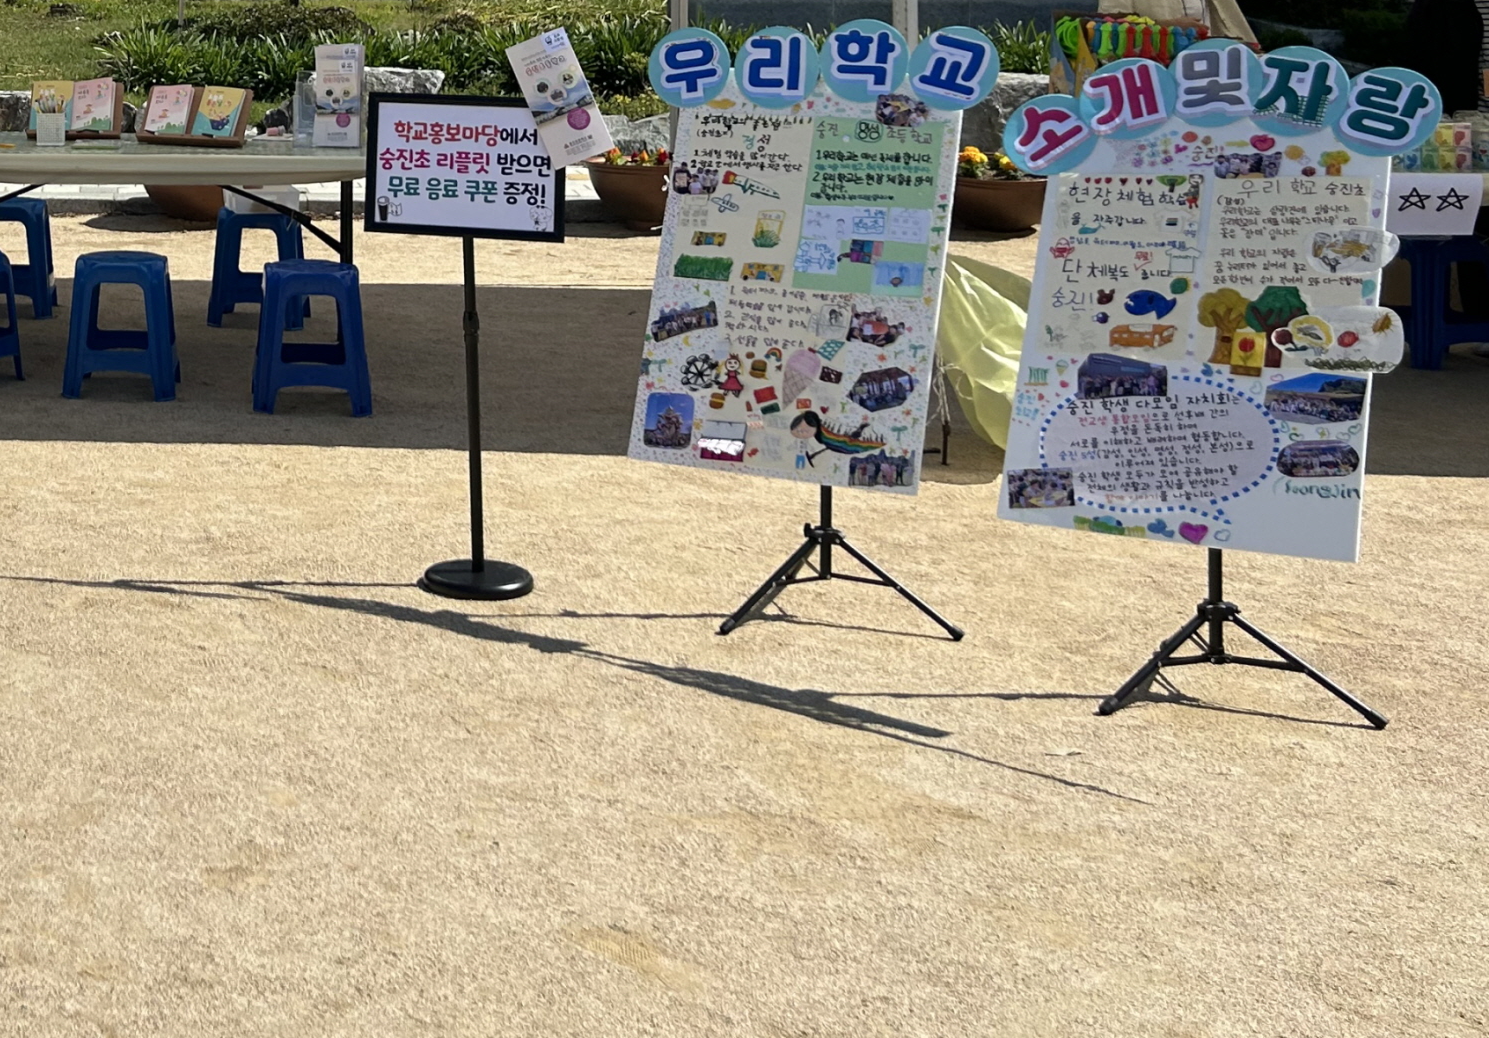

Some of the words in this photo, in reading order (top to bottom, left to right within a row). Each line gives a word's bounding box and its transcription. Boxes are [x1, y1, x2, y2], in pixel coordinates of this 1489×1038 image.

[393, 121, 539, 147] 학교홍보마당에서
[379, 148, 432, 172] 숭진초
[436, 150, 491, 175] 리플릿
[496, 152, 552, 178] 받으면
[387, 176, 421, 199] 무료
[426, 177, 459, 201] 음료
[464, 179, 498, 204] 쿠폰
[503, 182, 546, 206] 증정!
[1290, 178, 1318, 195] 학교
[1325, 182, 1367, 197] 숭진초
[1066, 400, 1094, 416] 숭진
[1100, 397, 1130, 413] 학생
[1135, 394, 1178, 410] 다모임
[1186, 392, 1240, 405] 자치회는
[1077, 415, 1107, 427] 전교생
[1174, 409, 1205, 421] 선후배
[1209, 409, 1229, 419] 간의
[1110, 424, 1138, 435] 우정을
[1177, 422, 1198, 430] 하며
[1070, 437, 1099, 449] 서로를
[1103, 436, 1143, 445] 이해하고
[1146, 434, 1187, 443] 배려하며
[1078, 471, 1097, 483] 숭진
[1101, 470, 1121, 482] 학생
[1125, 470, 1155, 480] 모두가
[1159, 469, 1179, 478] 모여
[1155, 478, 1183, 490] 규칙을
[1188, 477, 1229, 489] 반성하고
